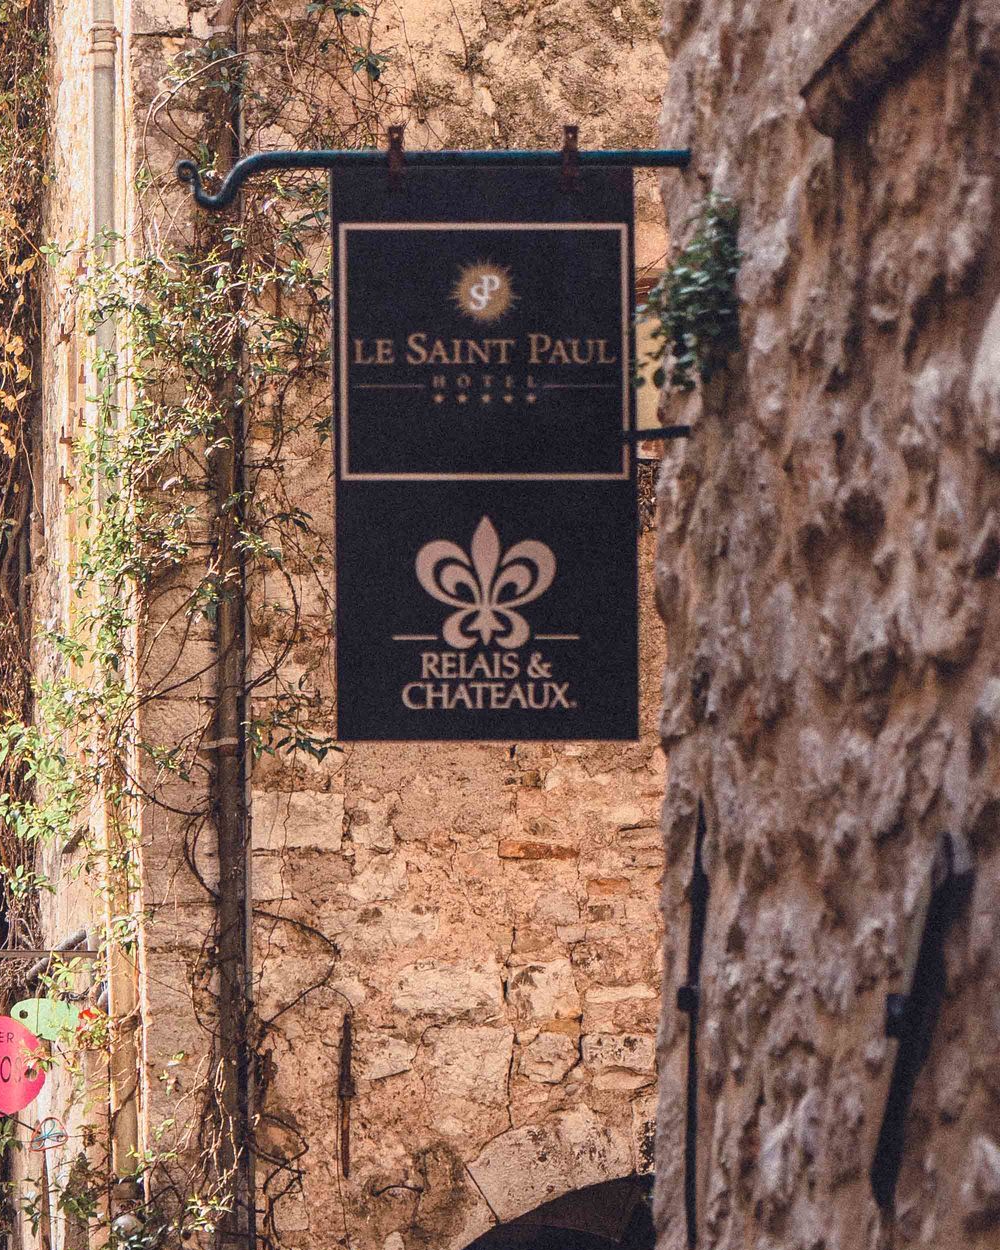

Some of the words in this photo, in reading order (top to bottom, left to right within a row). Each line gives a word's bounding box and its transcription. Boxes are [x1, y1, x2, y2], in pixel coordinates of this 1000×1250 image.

[353, 337, 395, 364] LE
[405, 332, 515, 365] SAINT
[527, 333, 617, 364] PAUL
[421, 652, 521, 679] RELAIS
[526, 652, 553, 678] &
